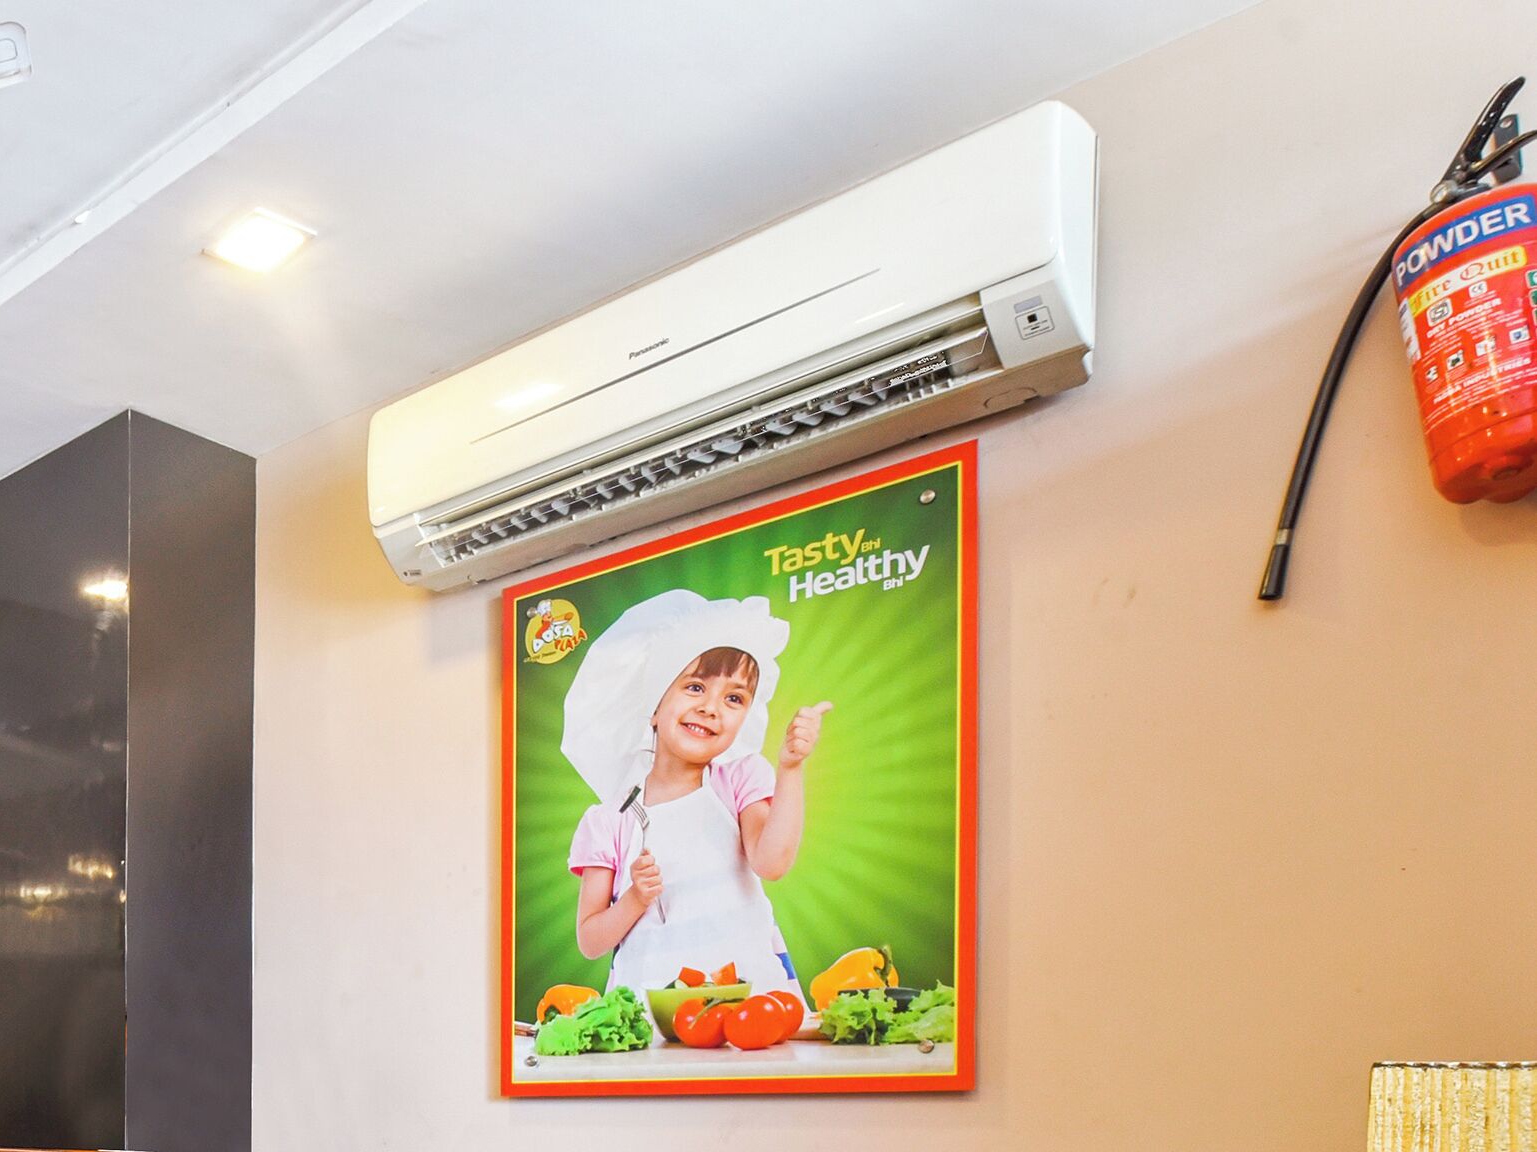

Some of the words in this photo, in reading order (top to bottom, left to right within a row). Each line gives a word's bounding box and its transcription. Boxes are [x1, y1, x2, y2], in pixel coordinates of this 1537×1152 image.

[1396, 203, 1531, 287] POWDER
[1460, 251, 1519, 280] Quit
[1448, 297, 1502, 326] POWDER
[628, 338, 669, 360] Panasonic
[764, 528, 865, 576] Tasty
[789, 544, 930, 603] Healthy
[532, 623, 574, 654] DOSA
